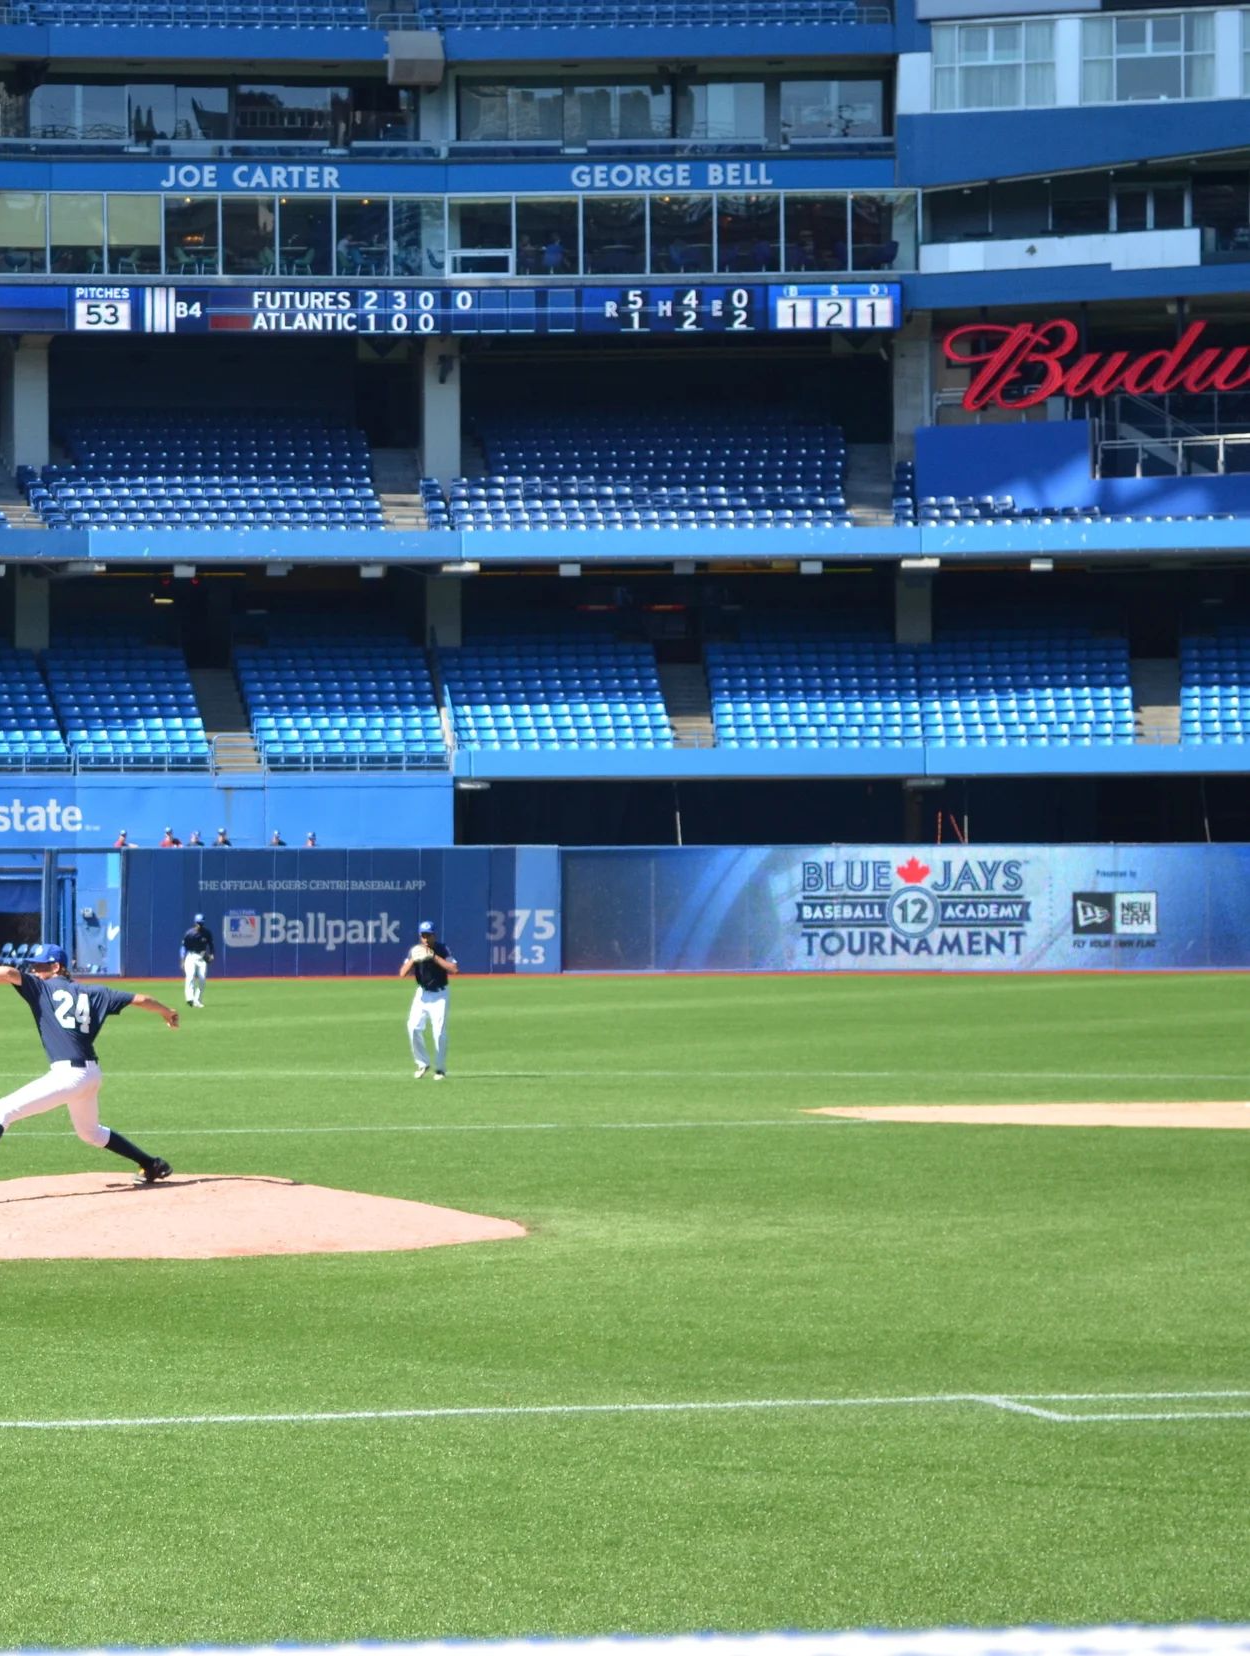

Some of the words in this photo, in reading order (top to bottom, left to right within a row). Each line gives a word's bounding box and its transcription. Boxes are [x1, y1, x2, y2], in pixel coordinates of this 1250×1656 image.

[161, 165, 217, 188] JOE
[232, 166, 341, 188] CARTER
[571, 164, 691, 187] GEORGE
[707, 163, 773, 186] BELL
[75, 287, 129, 299] PITCHES
[253, 290, 351, 310] FUTURES
[364, 291, 378, 310] 2
[393, 291, 407, 310] 3
[419, 291, 434, 310] 0
[456, 291, 472, 310] 0
[628, 290, 643, 309] 5
[683, 289, 698, 309] 4
[732, 289, 748, 308] 0
[85, 304, 119, 326] 53
[605, 301, 618, 317] R
[658, 301, 672, 317] H
[788, 302, 797, 327] 1
[826, 302, 843, 327] 2
[867, 301, 876, 326] 1
[253, 312, 357, 331] ATLANTIC
[368, 312, 377, 331] 1
[392, 312, 408, 331] 0
[419, 312, 434, 331] 0
[630, 311, 641, 329] 1
[683, 311, 697, 329] 2
[733, 310, 747, 328] 2
[198, 880, 219, 891] THE
[220, 880, 265, 891] OFFICIAL
[267, 880, 308, 891] ROGERS
[310, 880, 349, 890] CENTRE
[350, 880, 404, 890] BASEBALL
[405, 880, 427, 890] APP
[801, 860, 892, 893] BLUE
[931, 860, 1024, 893] JAYS
[802, 905, 882, 919] BASEBALL
[896, 898, 929, 924] 12
[944, 904, 1023, 919] ACADEMY
[1121, 901, 1151, 913] NEW
[486, 909, 556, 940] 375
[1121, 913, 1151, 925] ERA
[262, 911, 401, 951] Ballpark
[801, 930, 1027, 957] TOURNAMENT
[492, 945, 546, 965] 114.3
[52, 988, 92, 1034] 24
